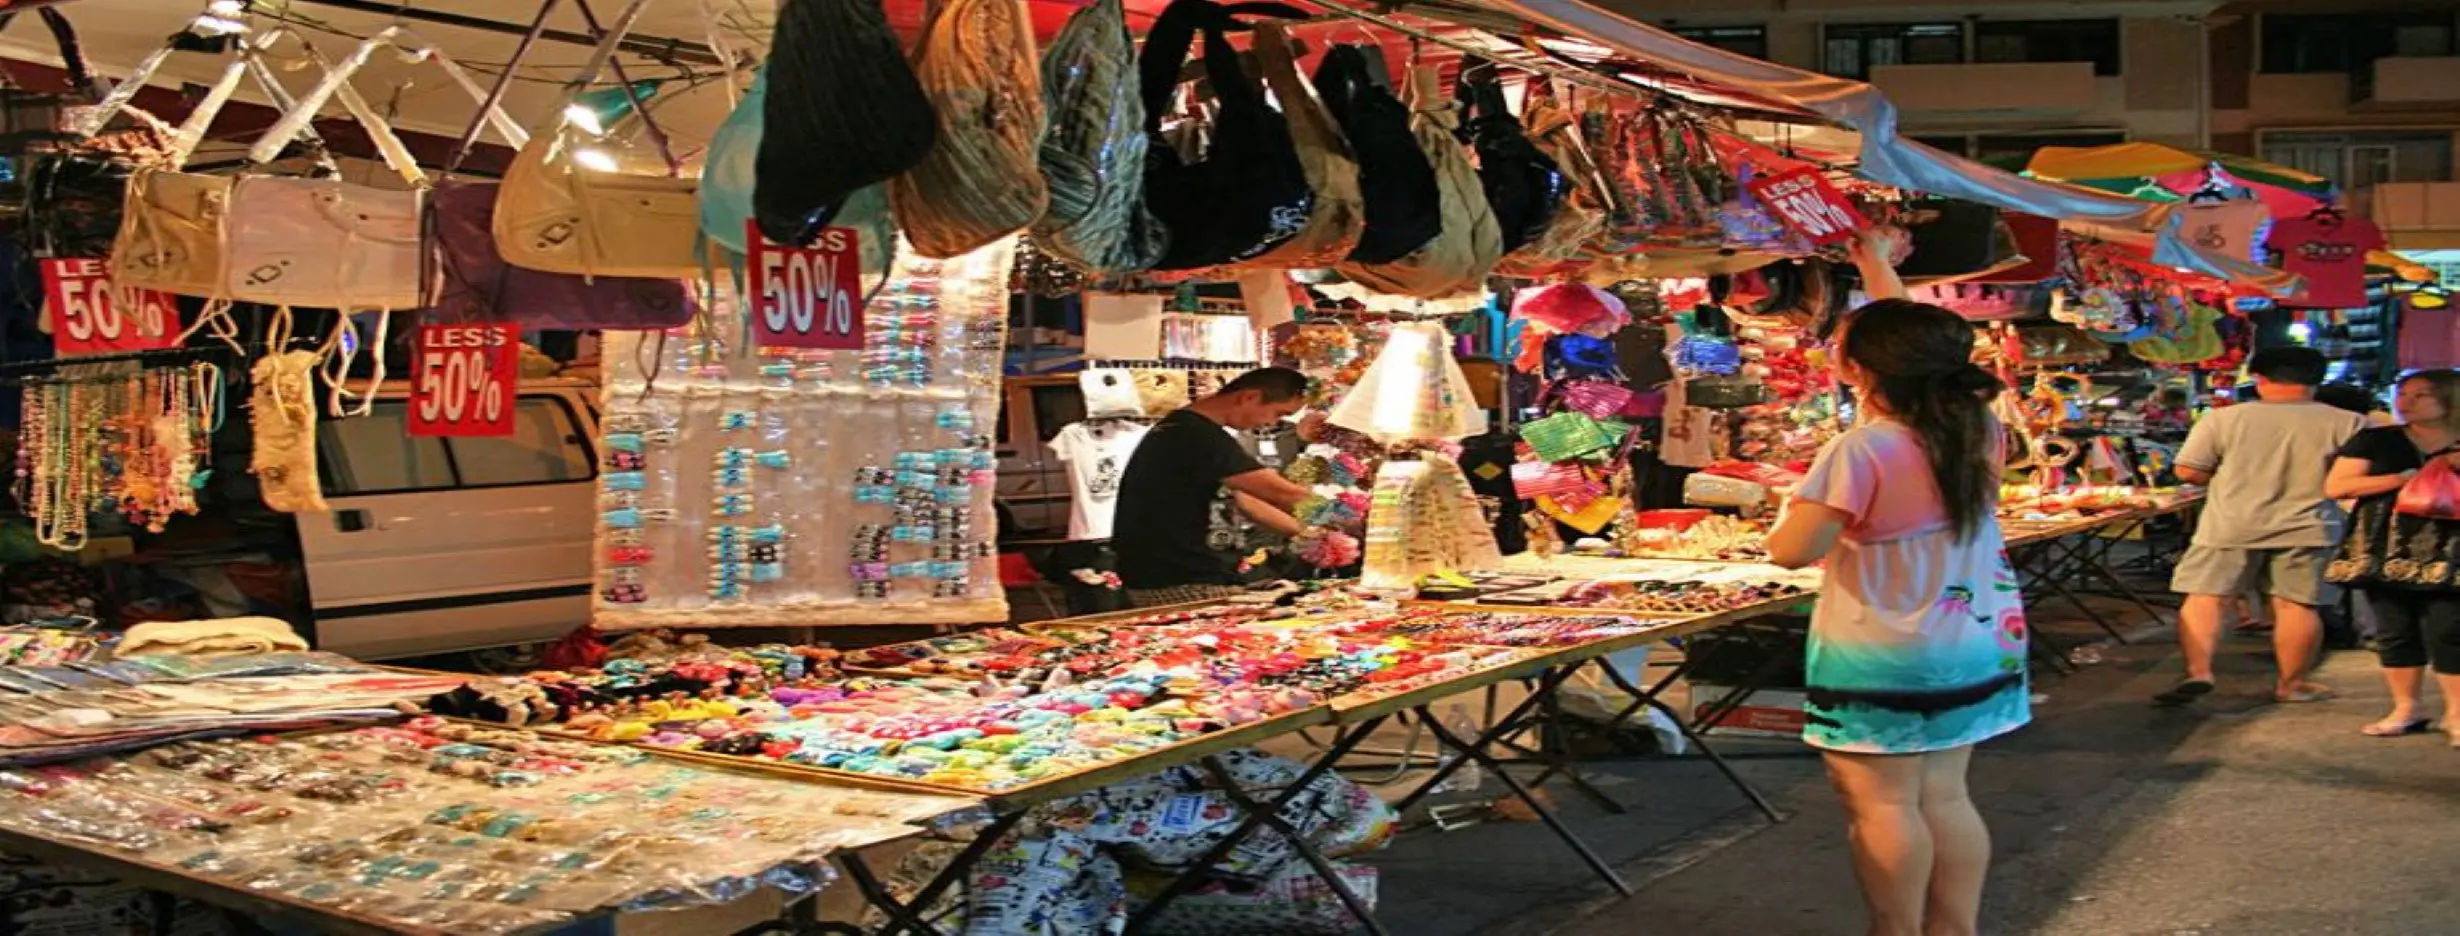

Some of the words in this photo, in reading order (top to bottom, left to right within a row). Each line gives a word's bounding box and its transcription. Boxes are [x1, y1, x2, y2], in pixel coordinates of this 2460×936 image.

[1760, 174, 1816, 200] LESS
[1774, 188, 1853, 236] 50%
[761, 230, 847, 252] SS
[57, 260, 114, 278] LE
[61, 279, 164, 340] 50%
[762, 252, 851, 335] 50%
[424, 327, 507, 348] LESS
[420, 351, 502, 422] 50%
